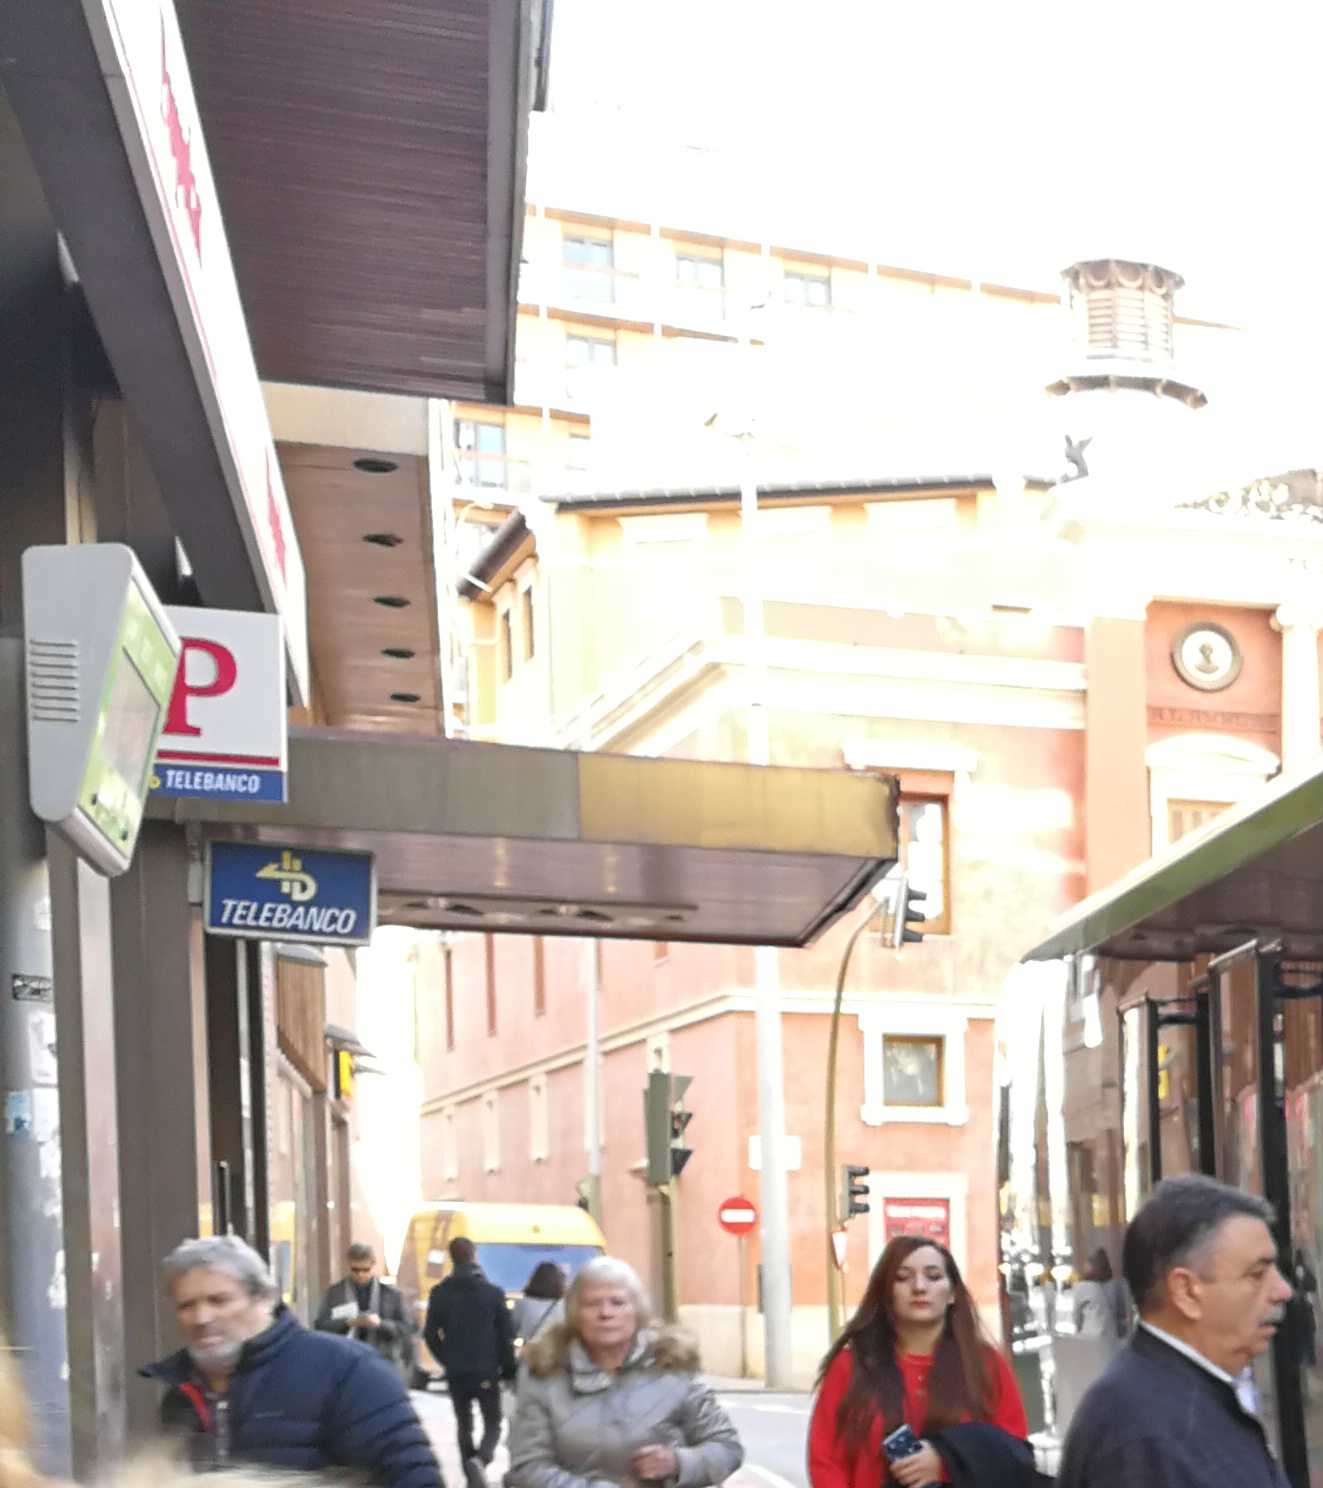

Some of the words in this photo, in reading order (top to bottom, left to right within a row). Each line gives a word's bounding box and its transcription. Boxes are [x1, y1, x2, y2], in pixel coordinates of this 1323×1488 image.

[162, 636, 238, 738] P
[165, 769, 260, 793] TELEBANCO
[220, 897, 357, 934] TELEBANCO
